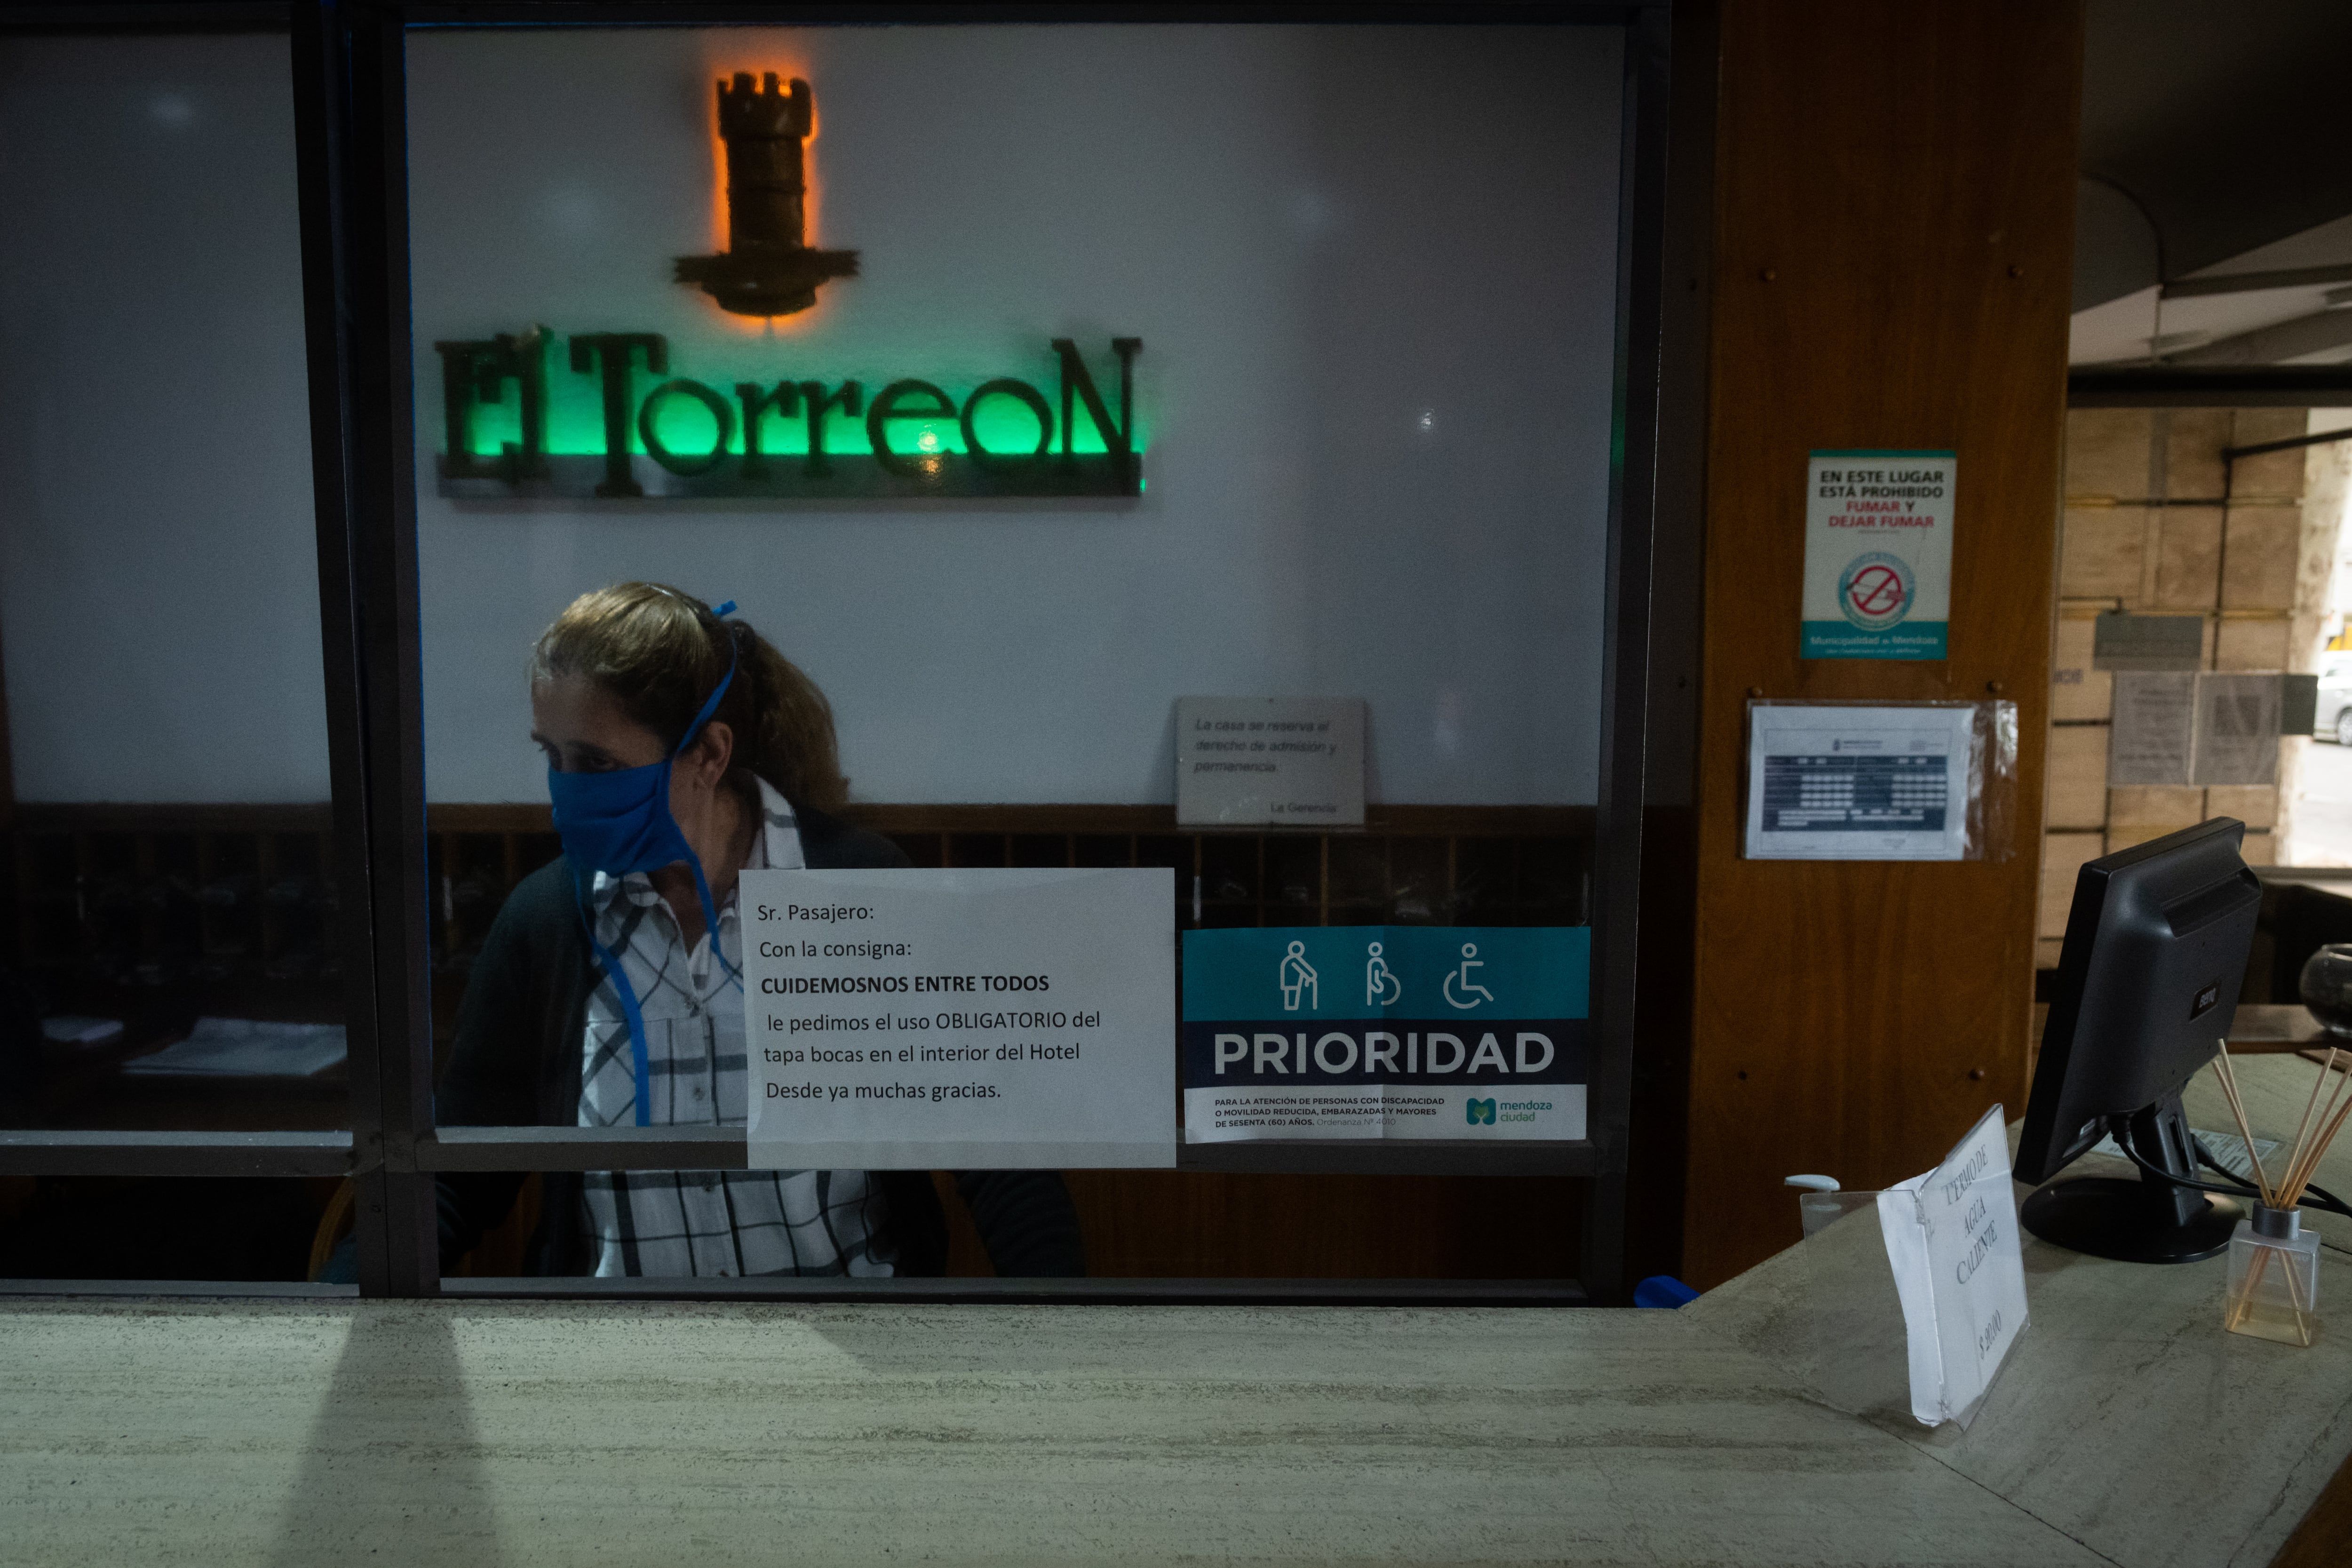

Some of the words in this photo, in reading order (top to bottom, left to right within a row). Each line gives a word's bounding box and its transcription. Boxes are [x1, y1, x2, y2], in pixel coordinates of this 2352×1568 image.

[435, 325, 549, 481] El
[1821, 471, 1842, 482] EN
[1847, 471, 1883, 483] ESTE
[1890, 471, 1944, 483] LUGAR
[1820, 484, 1855, 497] ESTÁ
[1862, 487, 1942, 497] PROHIBIDO
[1846, 501, 1900, 511] FUMAR
[1905, 502, 1915, 512] Y
[1829, 516, 1875, 526] DEJAR
[1881, 517, 1934, 527] FUMAR
[1195, 718, 1211, 731] La
[1215, 721, 1245, 731] casa
[758, 905, 781, 921] Sr.
[788, 904, 874, 924] Pasajero:
[760, 941, 795, 957] Con
[802, 940, 817, 957] la
[823, 940, 911, 960] consigna:
[761, 977, 908, 994] CUIDEMOSNOS
[915, 976, 976, 992] ENTRE
[981, 975, 1049, 991] TODOS
[768, 1014, 783, 1031] le
[790, 1014, 869, 1035] pedimos
[875, 1013, 890, 1030] el
[898, 1017, 930, 1030] uso
[936, 1012, 1066, 1029] OBLIGATORIO
[1072, 1011, 1100, 1027] del
[764, 1048, 804, 1066] tapa
[811, 1046, 864, 1062] bocas
[869, 1050, 892, 1062] en
[898, 1045, 914, 1062] el
[921, 1045, 990, 1061] interior
[995, 1043, 1023, 1060] del
[1030, 1043, 1080, 1060] Hotel
[1215, 1032, 1554, 1075] PRIORIDAD
[767, 1082, 823, 1098] Desde
[828, 1086, 849, 1102] ya
[855, 1082, 926, 1098] muchas
[931, 1082, 1001, 1102] gracias.
[1273, 1108, 1319, 1117] REDUCIDA,
[1500, 1100, 1552, 1110] mendoza
[1288, 1117, 1315, 1126] AÑOS.
[1500, 1112, 1535, 1122] ciudad
[1941, 1158, 1977, 1206] TERMO
[1976, 1144, 1988, 1173] DE
[1965, 1195, 1986, 1238] AGUA
[1956, 1220, 1998, 1285] CALIENTE
